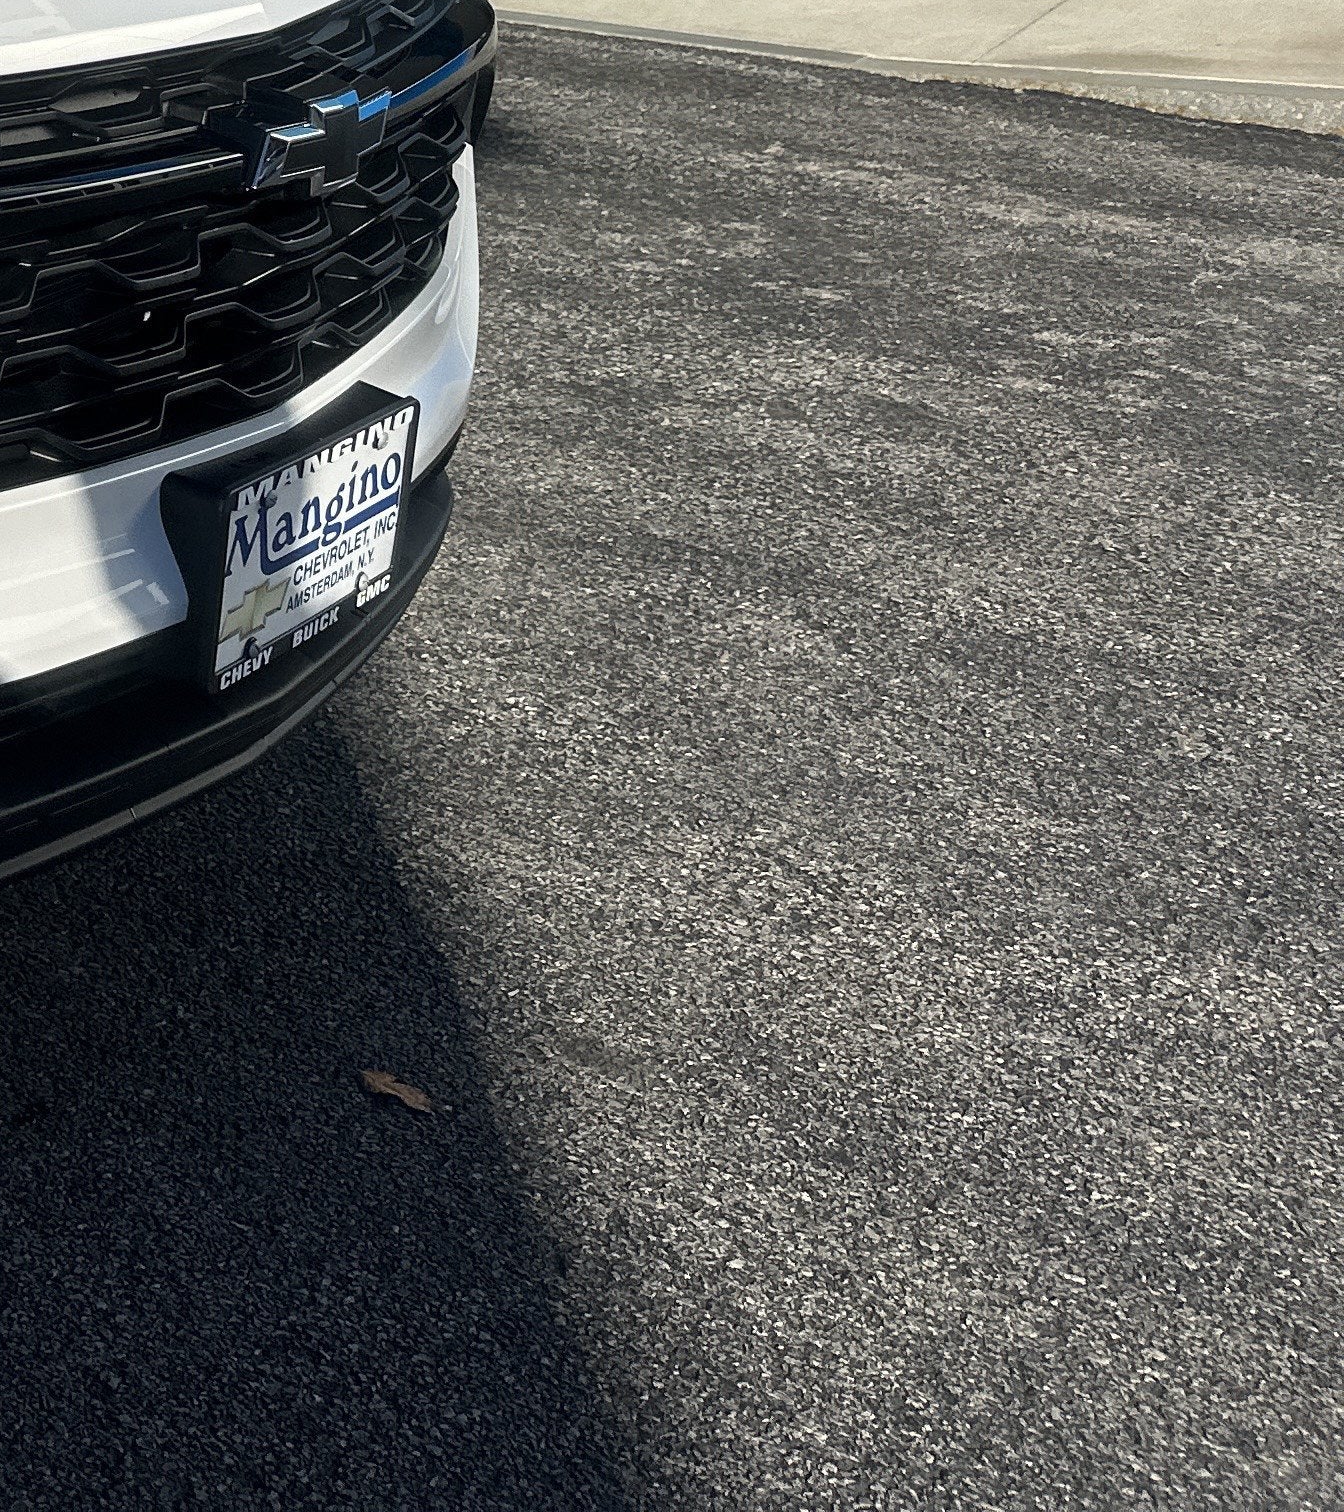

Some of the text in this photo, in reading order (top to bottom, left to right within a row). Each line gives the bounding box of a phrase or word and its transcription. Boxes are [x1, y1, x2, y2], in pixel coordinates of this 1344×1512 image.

[236, 406, 414, 511] MANGINO
[225, 451, 401, 577] Mangino
[293, 525, 370, 586] CHEVROLET,
[219, 573, 392, 691] CHEVY BUICK GMC
[286, 547, 376, 614] AMSTERDAM, N.Y.
